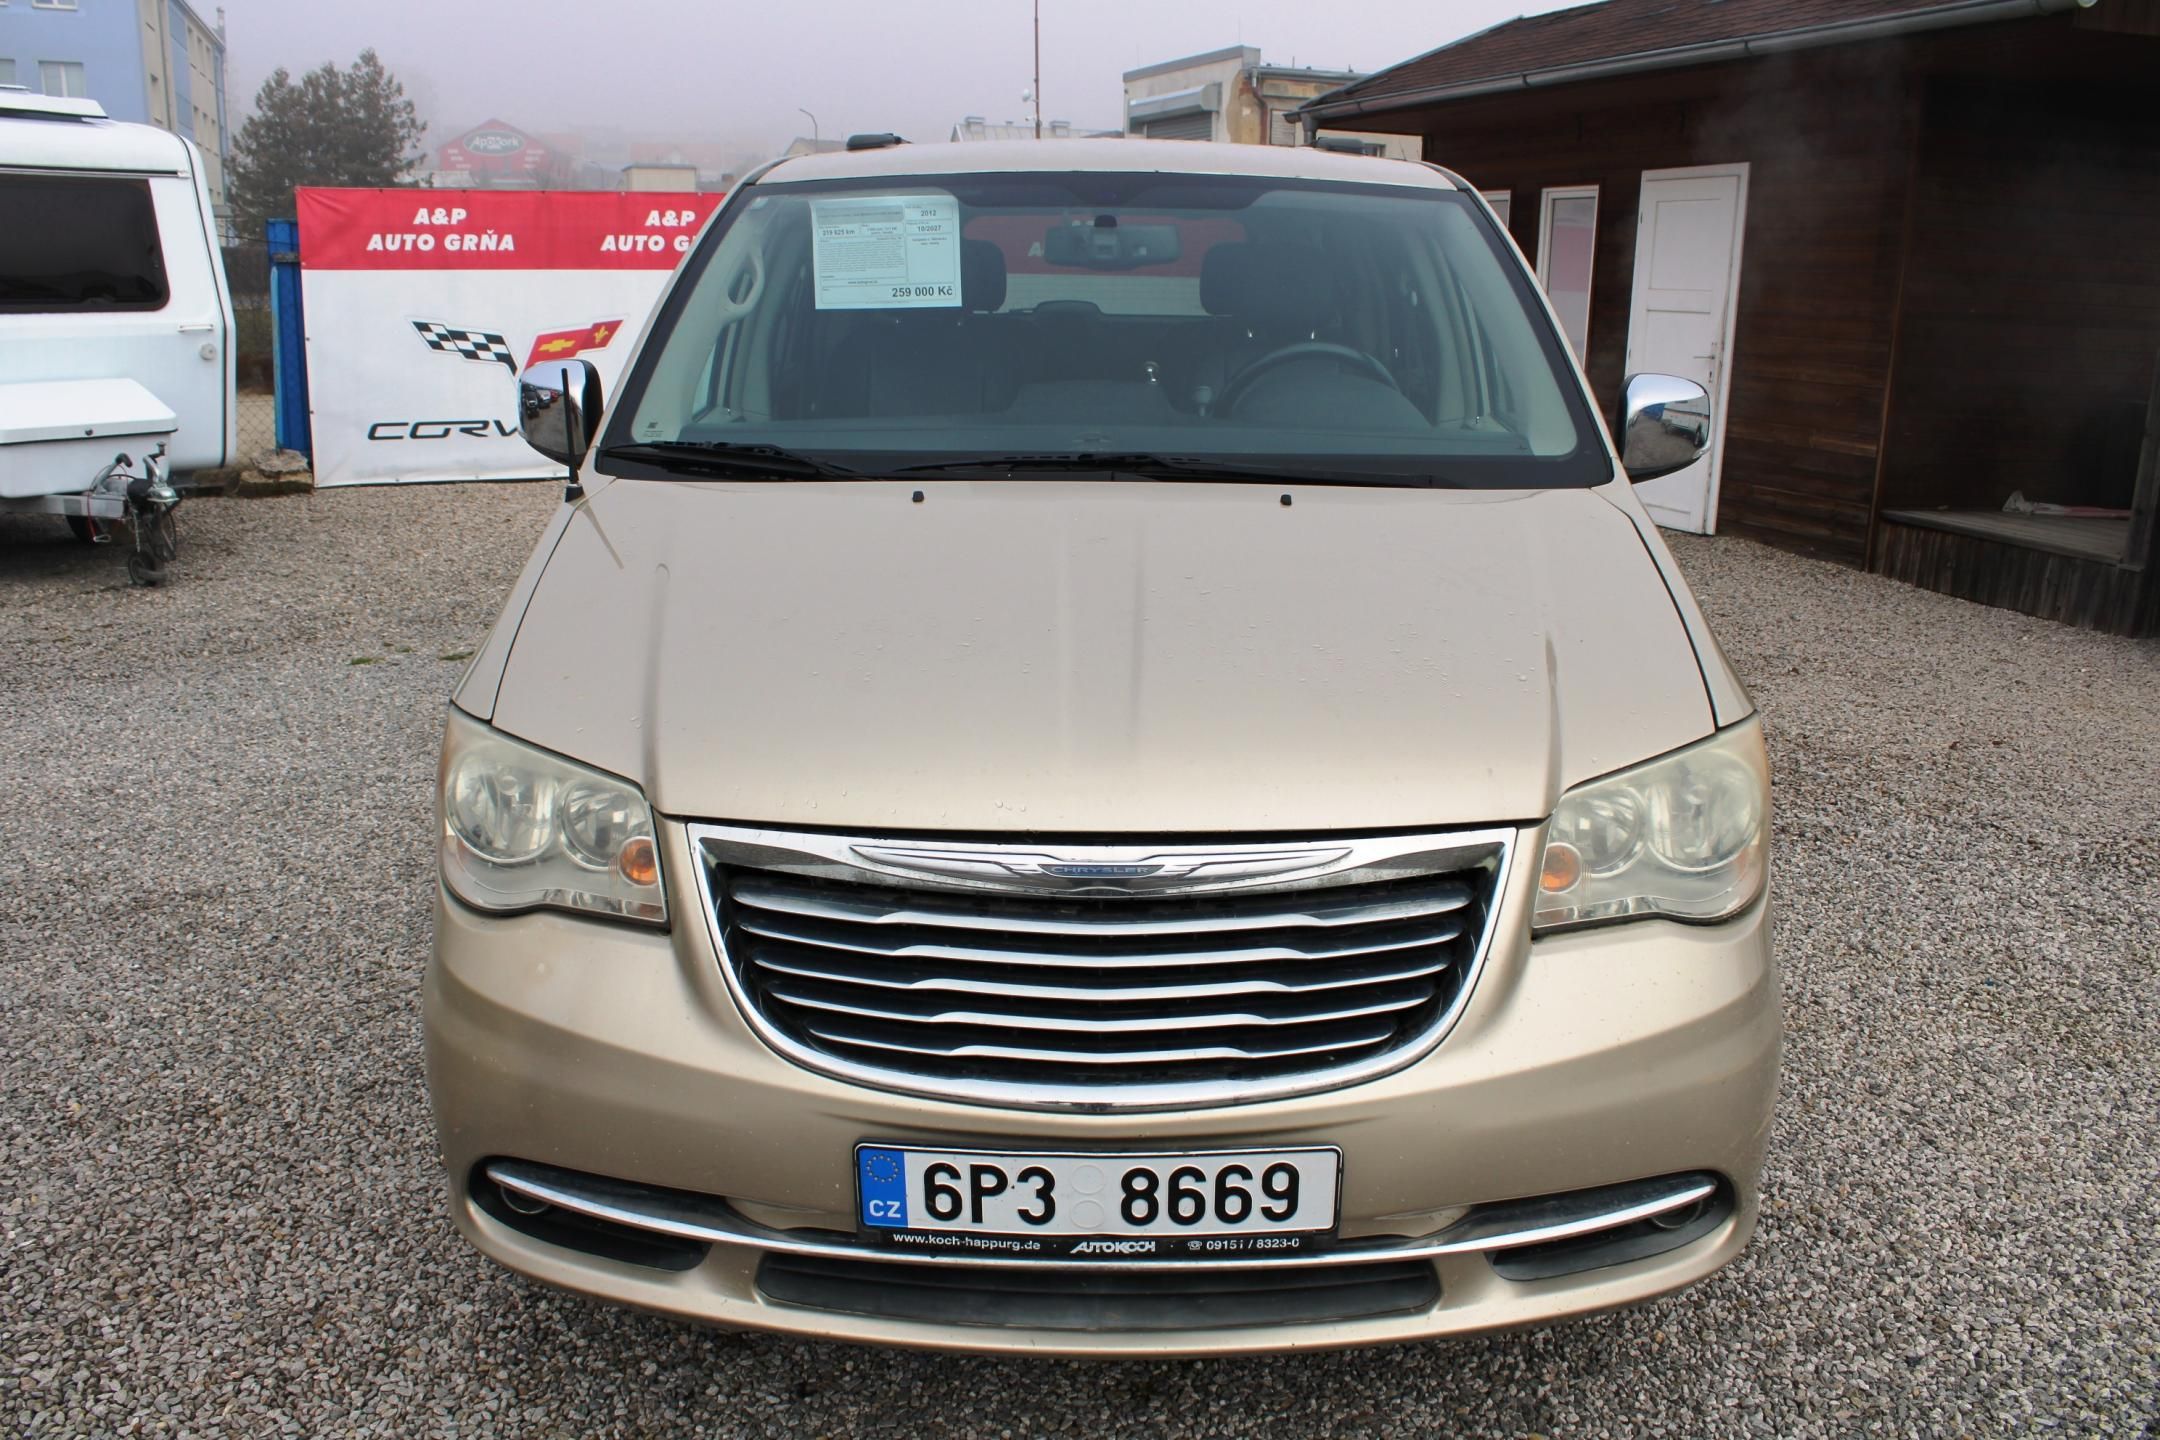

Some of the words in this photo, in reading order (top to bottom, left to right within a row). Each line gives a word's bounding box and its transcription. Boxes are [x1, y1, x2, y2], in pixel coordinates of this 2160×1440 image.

[413, 208, 467, 225] A&P
[645, 210, 696, 227] A&P
[920, 209, 937, 217] 2012
[366, 233, 435, 251] AUTO
[444, 229, 515, 251] GRŇA
[600, 235, 666, 252] AUTO
[891, 287, 912, 298] 259
[914, 286, 935, 297] 000
[938, 285, 953, 296] Kč
[368, 420, 519, 441] CORV
[1051, 866, 1150, 874] CHRYSLER
[923, 1161, 1056, 1226] 6P3
[1120, 1161, 1300, 1227] 8669
[869, 1199, 901, 1218] CZ
[893, 1233, 1041, 1251] www.koch-happurg.de
[1256, 1237, 1300, 1249] 8323-0
